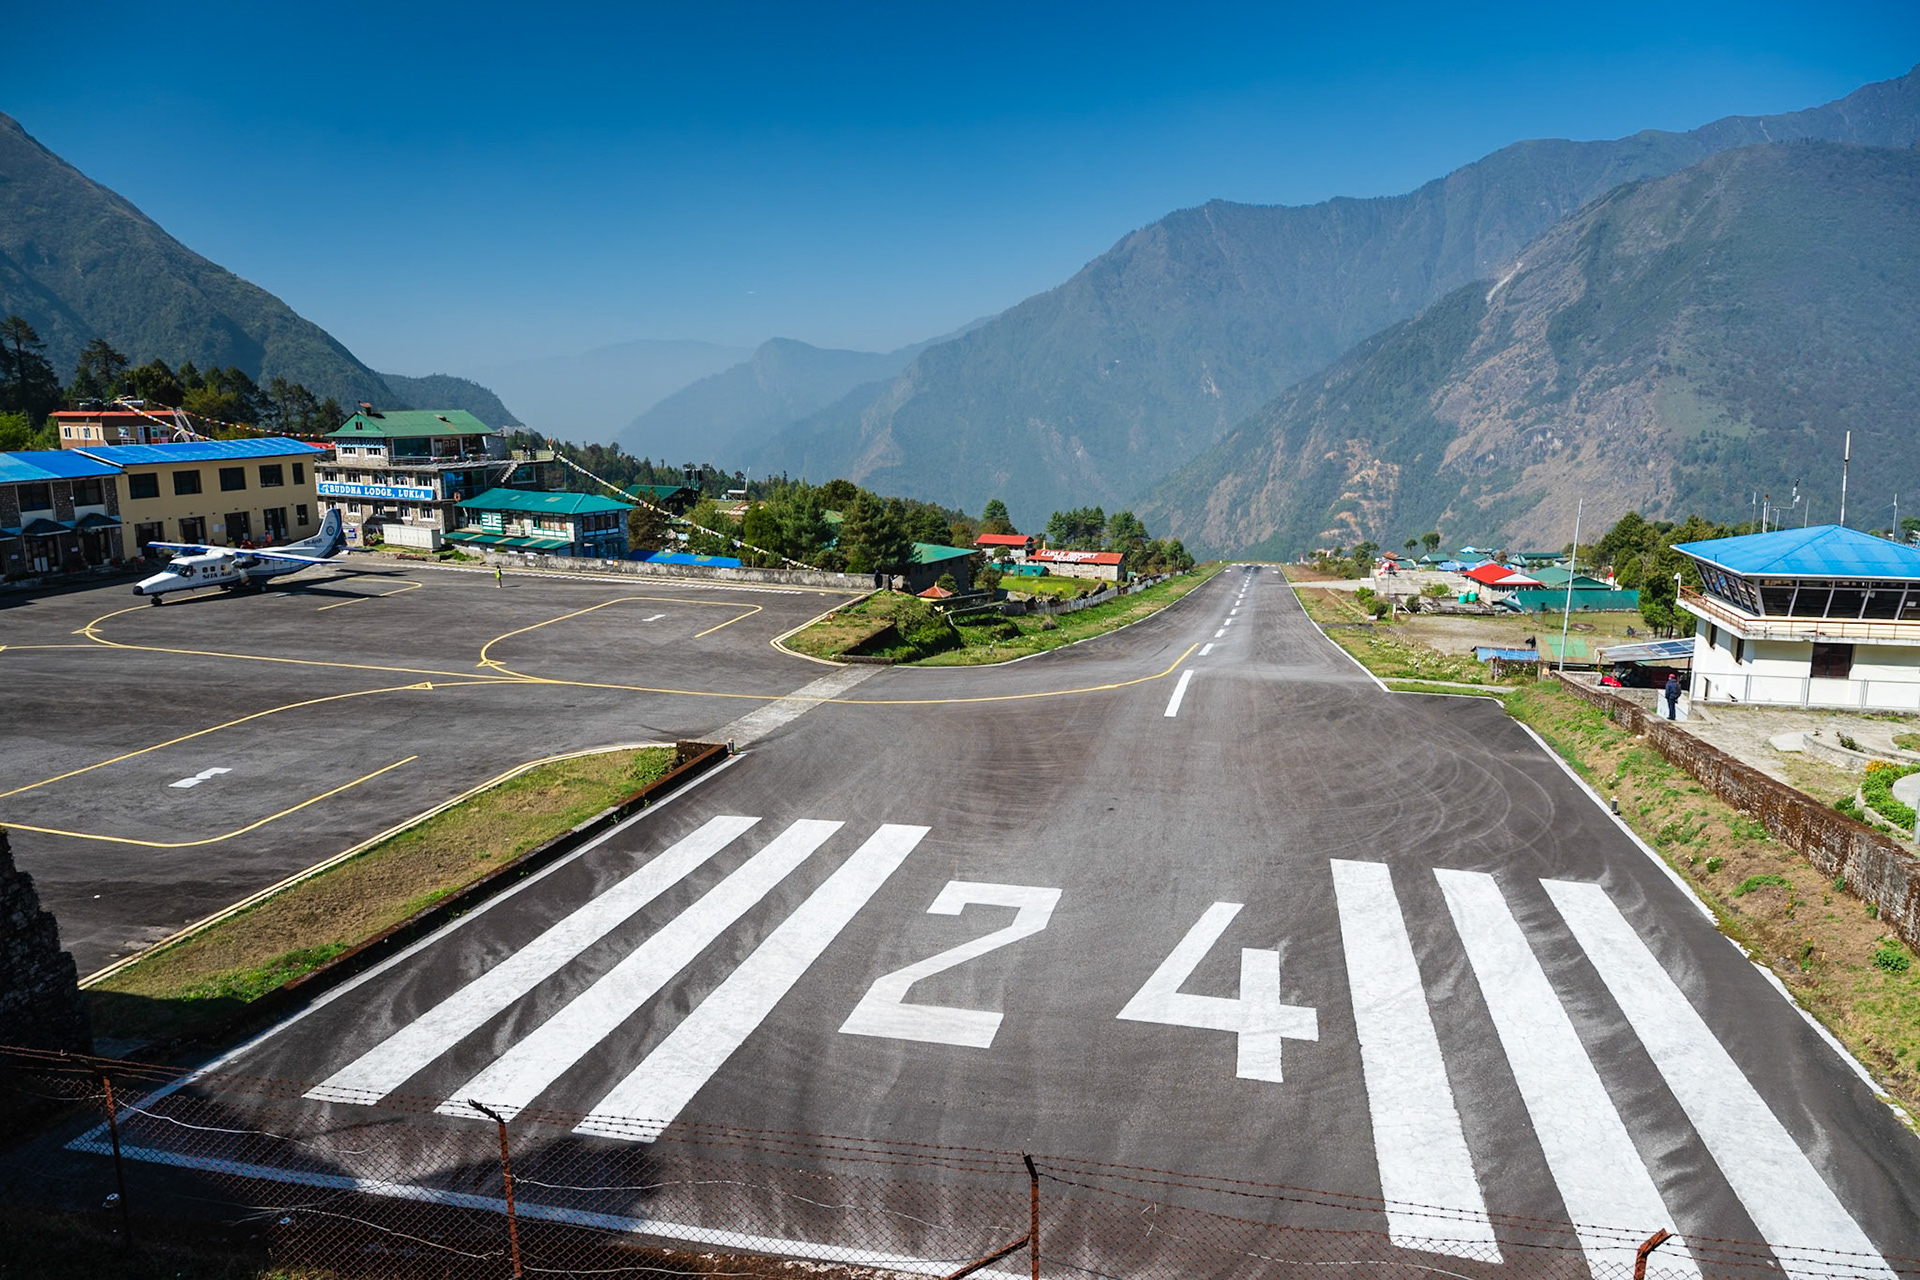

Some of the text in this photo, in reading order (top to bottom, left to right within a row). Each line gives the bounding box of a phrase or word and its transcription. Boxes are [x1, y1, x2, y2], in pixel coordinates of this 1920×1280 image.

[329, 484, 425, 499] BUDDHA LODGE, LUKLA
[838, 880, 1319, 1083] 24
